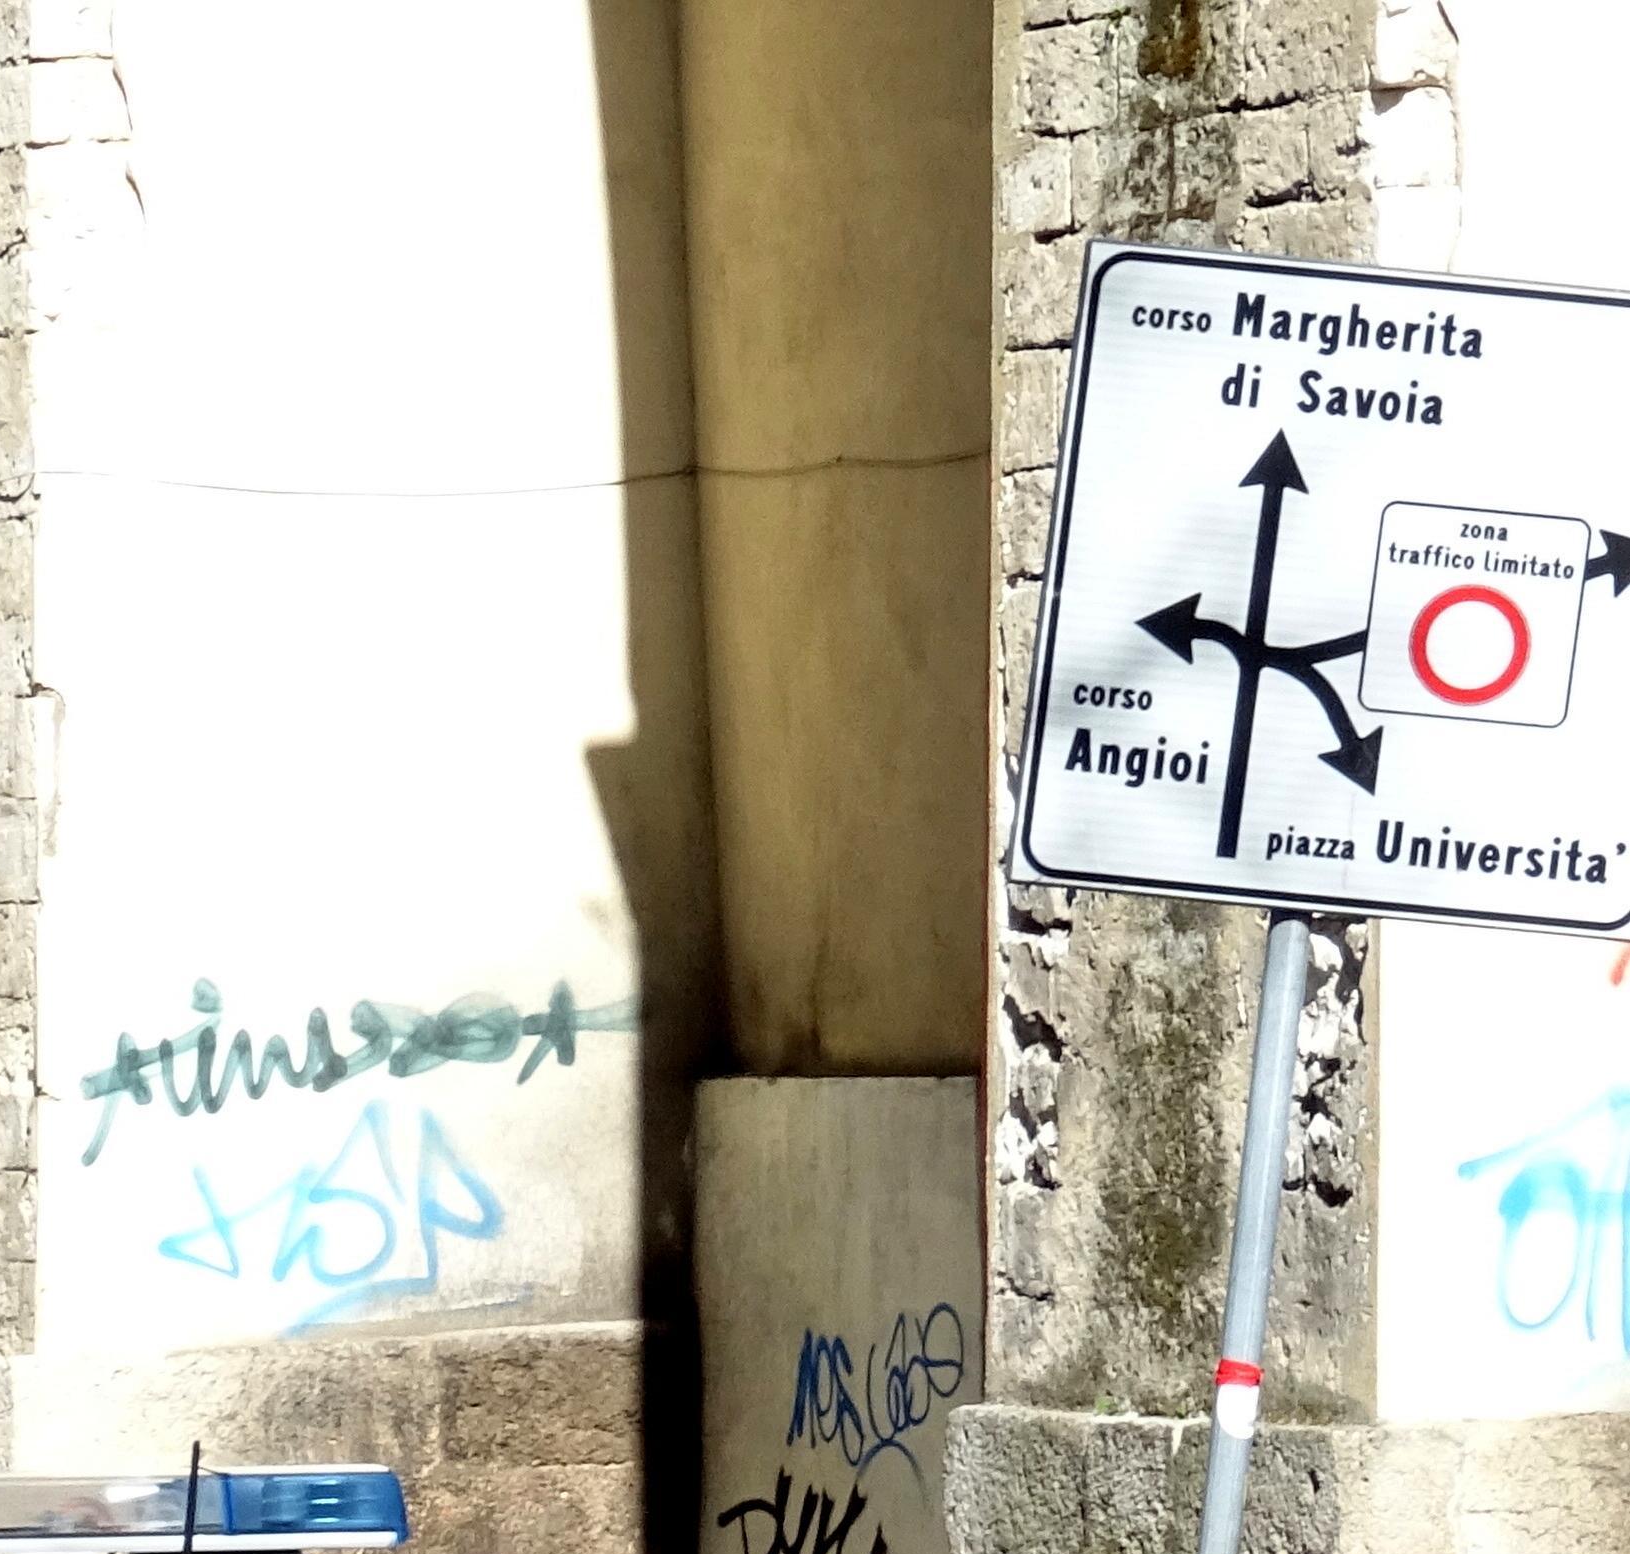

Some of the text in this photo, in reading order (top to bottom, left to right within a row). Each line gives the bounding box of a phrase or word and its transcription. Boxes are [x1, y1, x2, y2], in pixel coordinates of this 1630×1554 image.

[1132, 292, 1484, 359] corso Margherita
[1221, 363, 1443, 425] di Savoia
[1389, 542, 1575, 579] traffico limitato
[1460, 523, 1508, 541] zona
[1073, 683, 1153, 711] corso
[1064, 727, 1210, 788] Angioi
[1266, 819, 1627, 884] piazza Universita'
